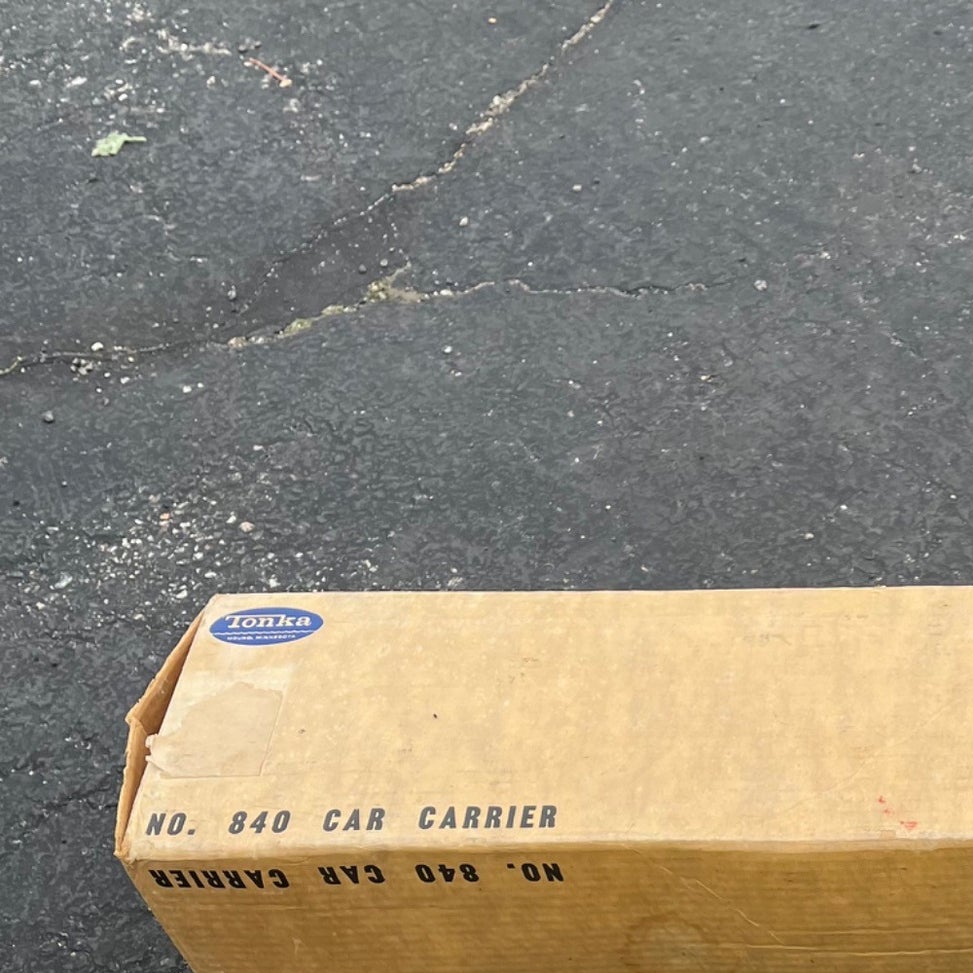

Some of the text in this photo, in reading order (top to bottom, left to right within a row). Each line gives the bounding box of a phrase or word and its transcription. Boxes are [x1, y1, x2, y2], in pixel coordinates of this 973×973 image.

[225, 614, 311, 628] Tonka
[145, 805, 558, 836] NO. 840 CAR CARRIER
[148, 862, 564, 889] NO. 840 CAR CARRIER
